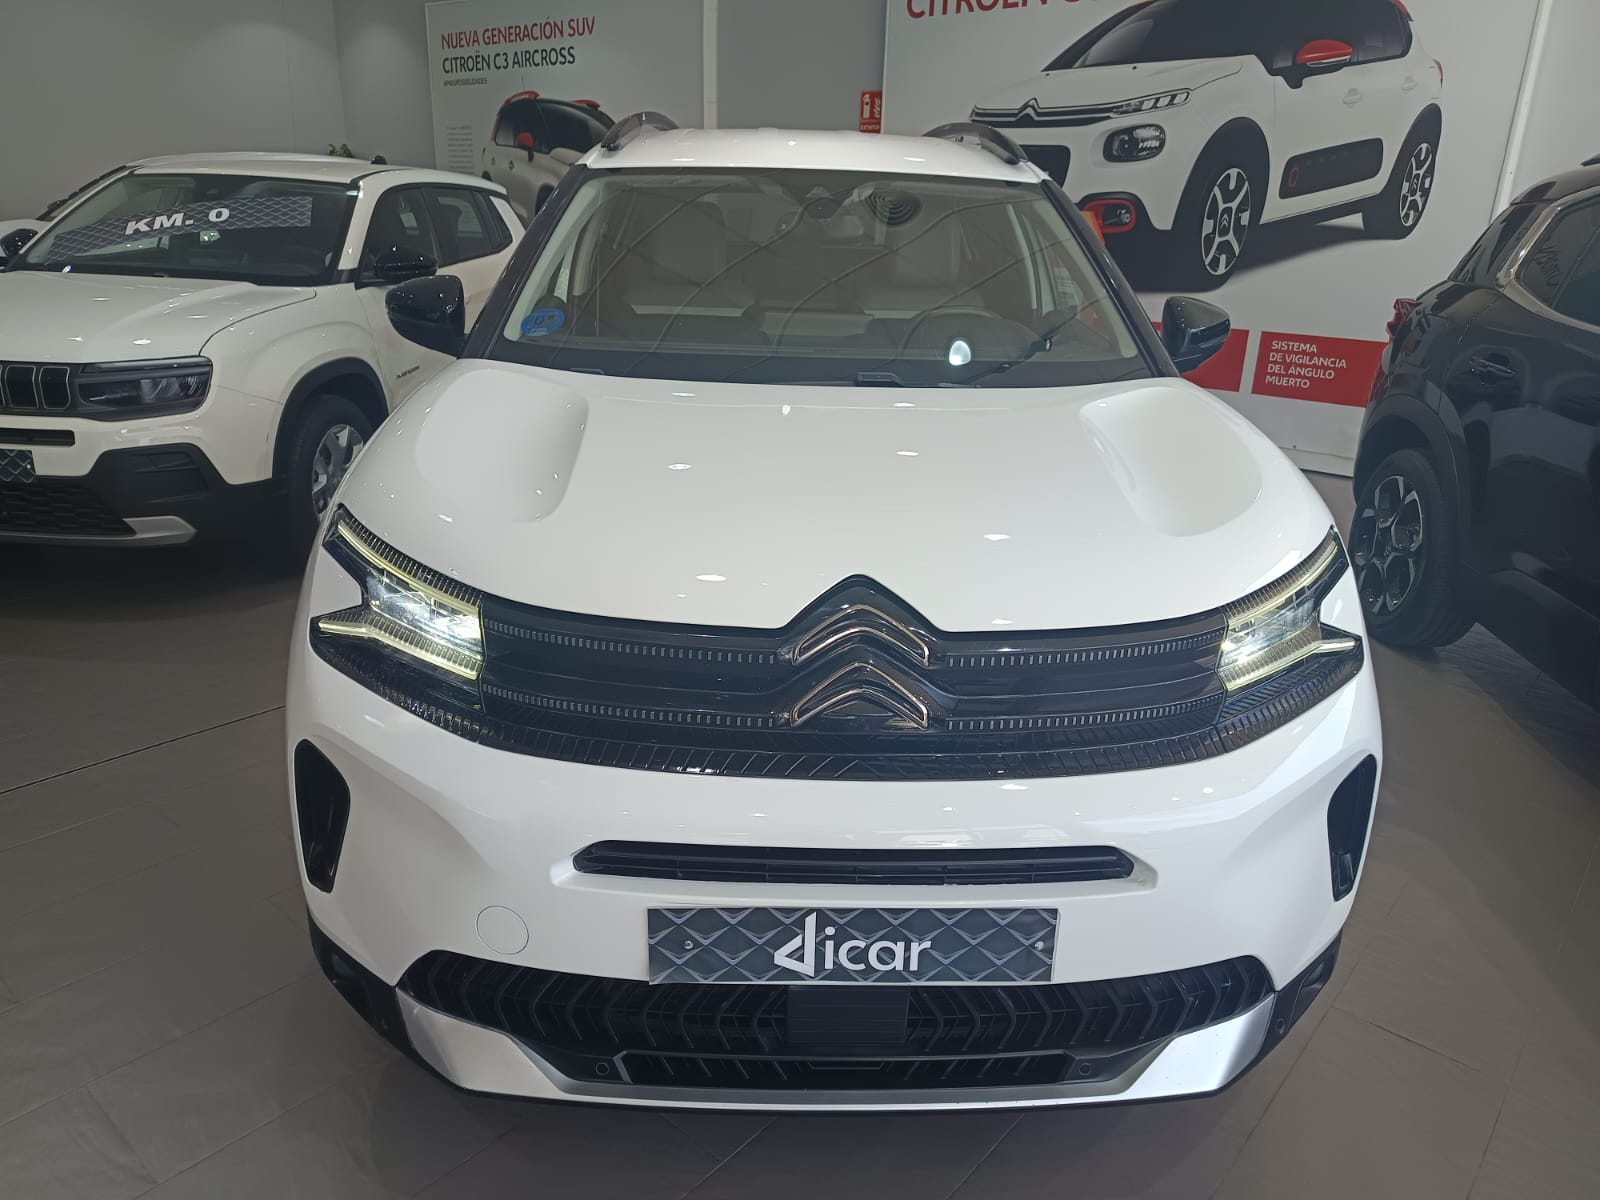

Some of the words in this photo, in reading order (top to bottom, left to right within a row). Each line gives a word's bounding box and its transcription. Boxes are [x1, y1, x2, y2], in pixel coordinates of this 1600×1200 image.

[441, 30, 481, 50] NUEVA
[482, 16, 564, 46] GENERACIÓN
[568, 16, 596, 38] SUV
[442, 50, 491, 74] CITROËN
[493, 52, 509, 70] C3
[512, 46, 576, 69] AIRCROSS
[124, 212, 194, 236] KM.
[1271, 340, 1317, 353] SISTEMA
[1269, 351, 1283, 362] DE
[1285, 354, 1347, 368] VIGILANCIA
[1267, 363, 1286, 374] DEL
[1288, 364, 1335, 379] ÁNGULO
[1265, 375, 1310, 389] MUERTO
